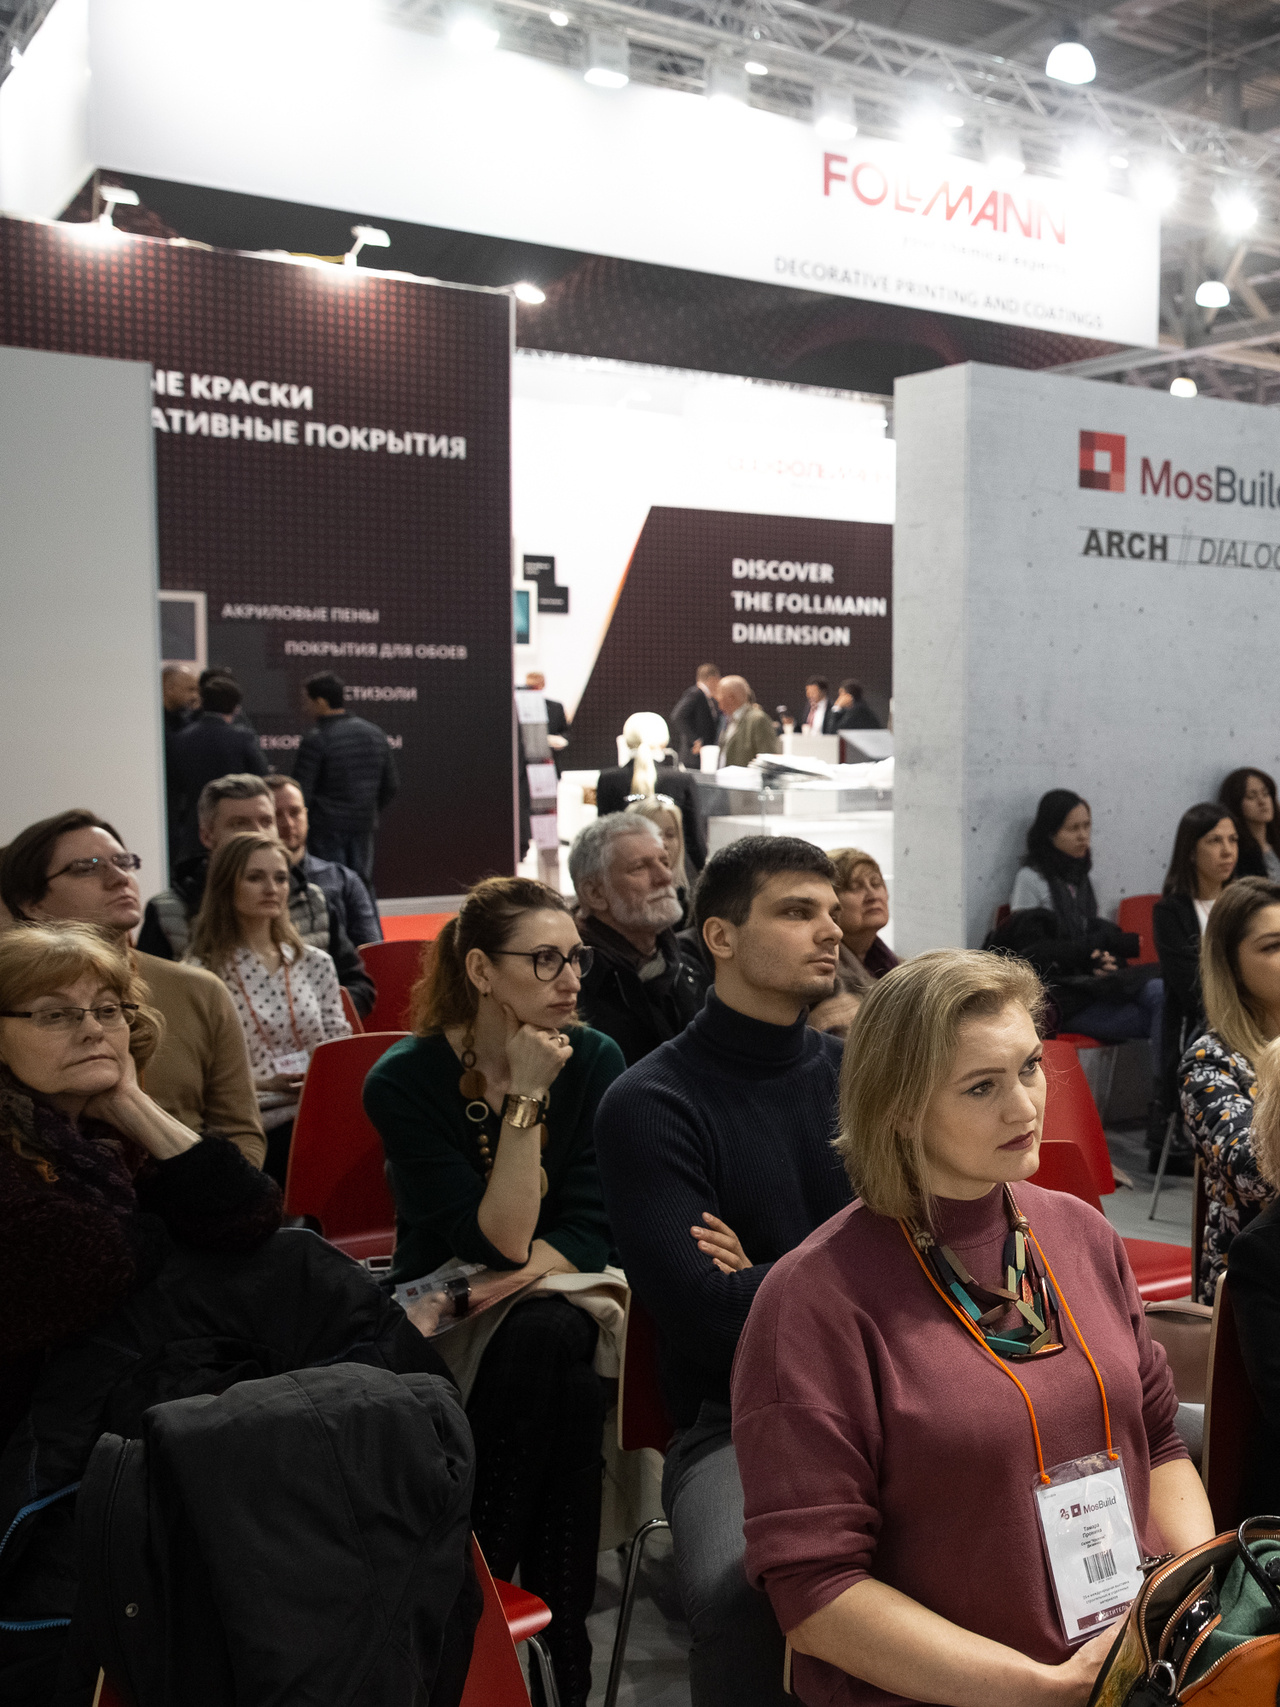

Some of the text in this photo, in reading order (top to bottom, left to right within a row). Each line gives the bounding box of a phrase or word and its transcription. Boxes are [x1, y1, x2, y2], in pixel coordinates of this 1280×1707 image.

[824, 152, 1066, 245] FOLLMANN
[774, 255, 1104, 331] DECORATIVE PRINTING AND COATINGS
[190, 373, 313, 410] КРАСКИ
[304, 421, 467, 460] ПОКРЫТИЯ
[1082, 528, 1168, 562] ARCH
[731, 558, 835, 584] DISCOVER
[221, 603, 379, 624] АКРИЛОВЫЕ ПЕНЫ
[731, 590, 887, 617] THE FOLLMANN
[731, 622, 850, 647] DIMENSION
[284, 640, 468, 660] ПОКРЫТИЯ ДЛЯ ОБОЕВ
[1083, 1496, 1117, 1515] MosBuild
